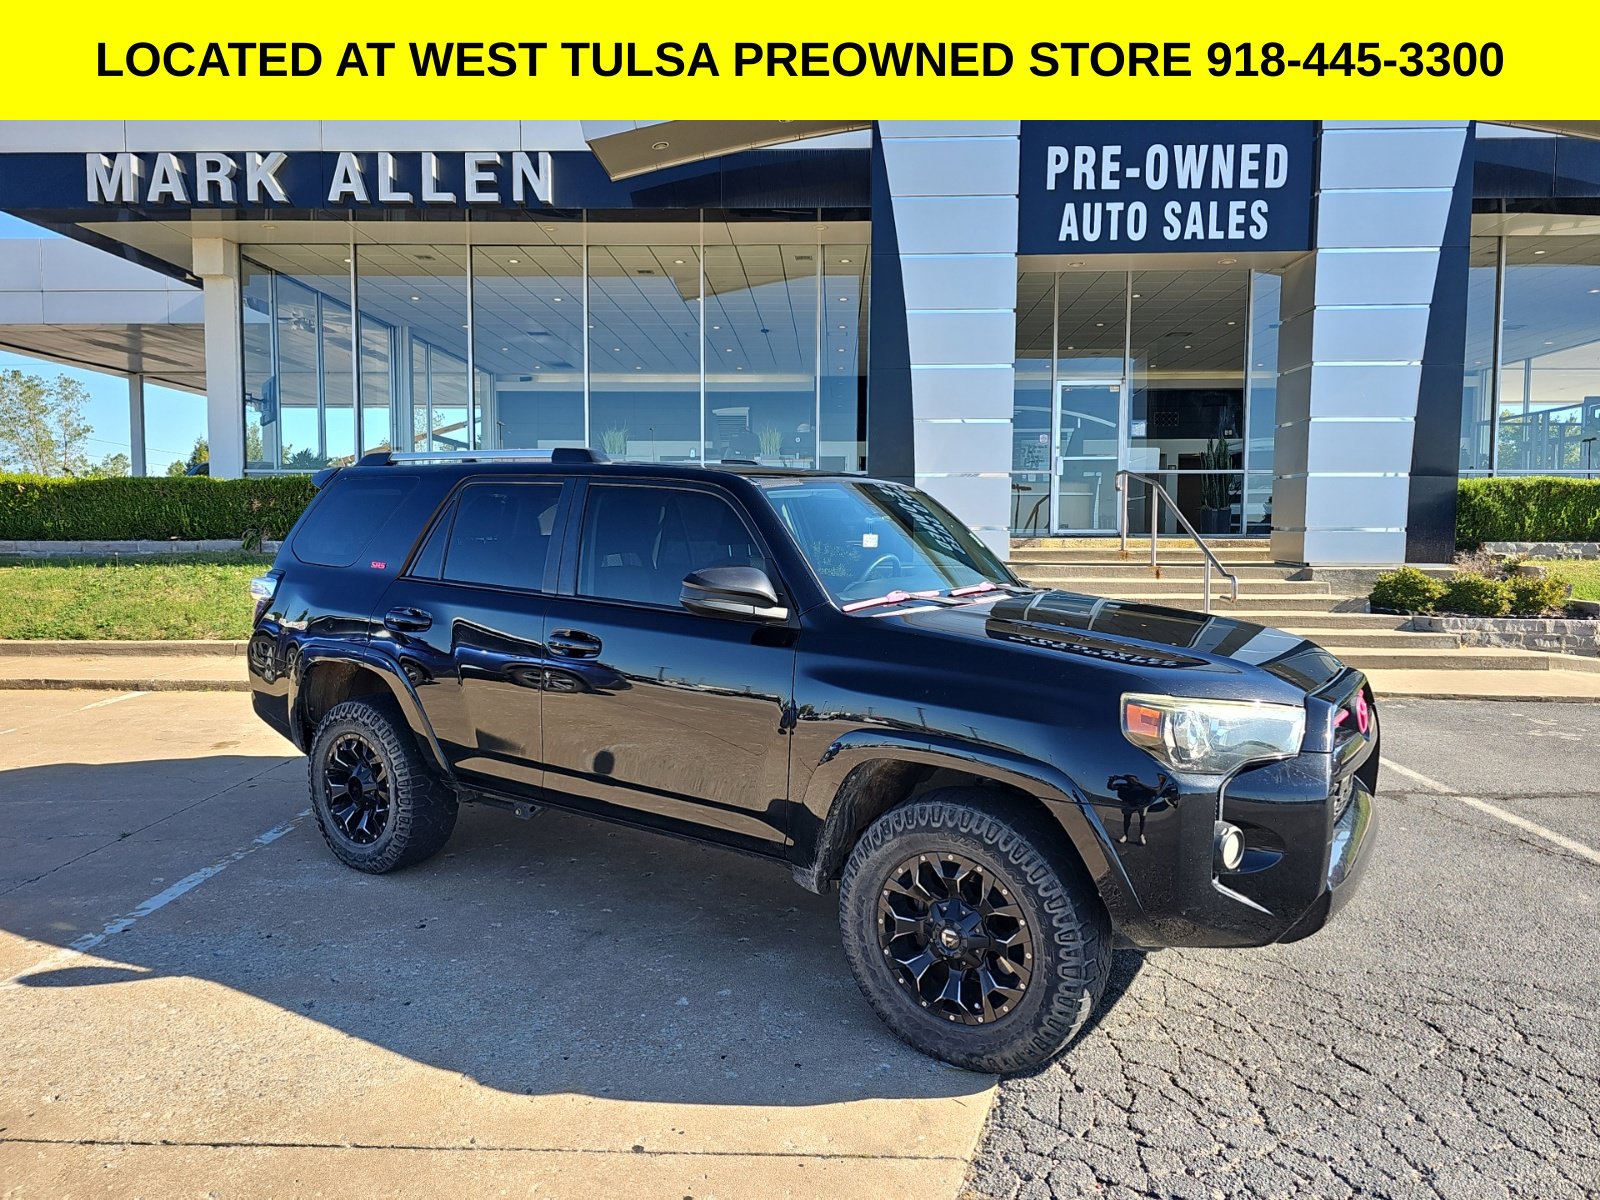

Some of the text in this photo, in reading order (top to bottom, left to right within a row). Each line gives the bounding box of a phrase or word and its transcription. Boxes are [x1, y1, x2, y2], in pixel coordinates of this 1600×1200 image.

[86, 152, 555, 205] MARK ALLEN
[1046, 143, 1289, 191] PRE-OWNED
[1058, 199, 1269, 242] AUTO SALES
